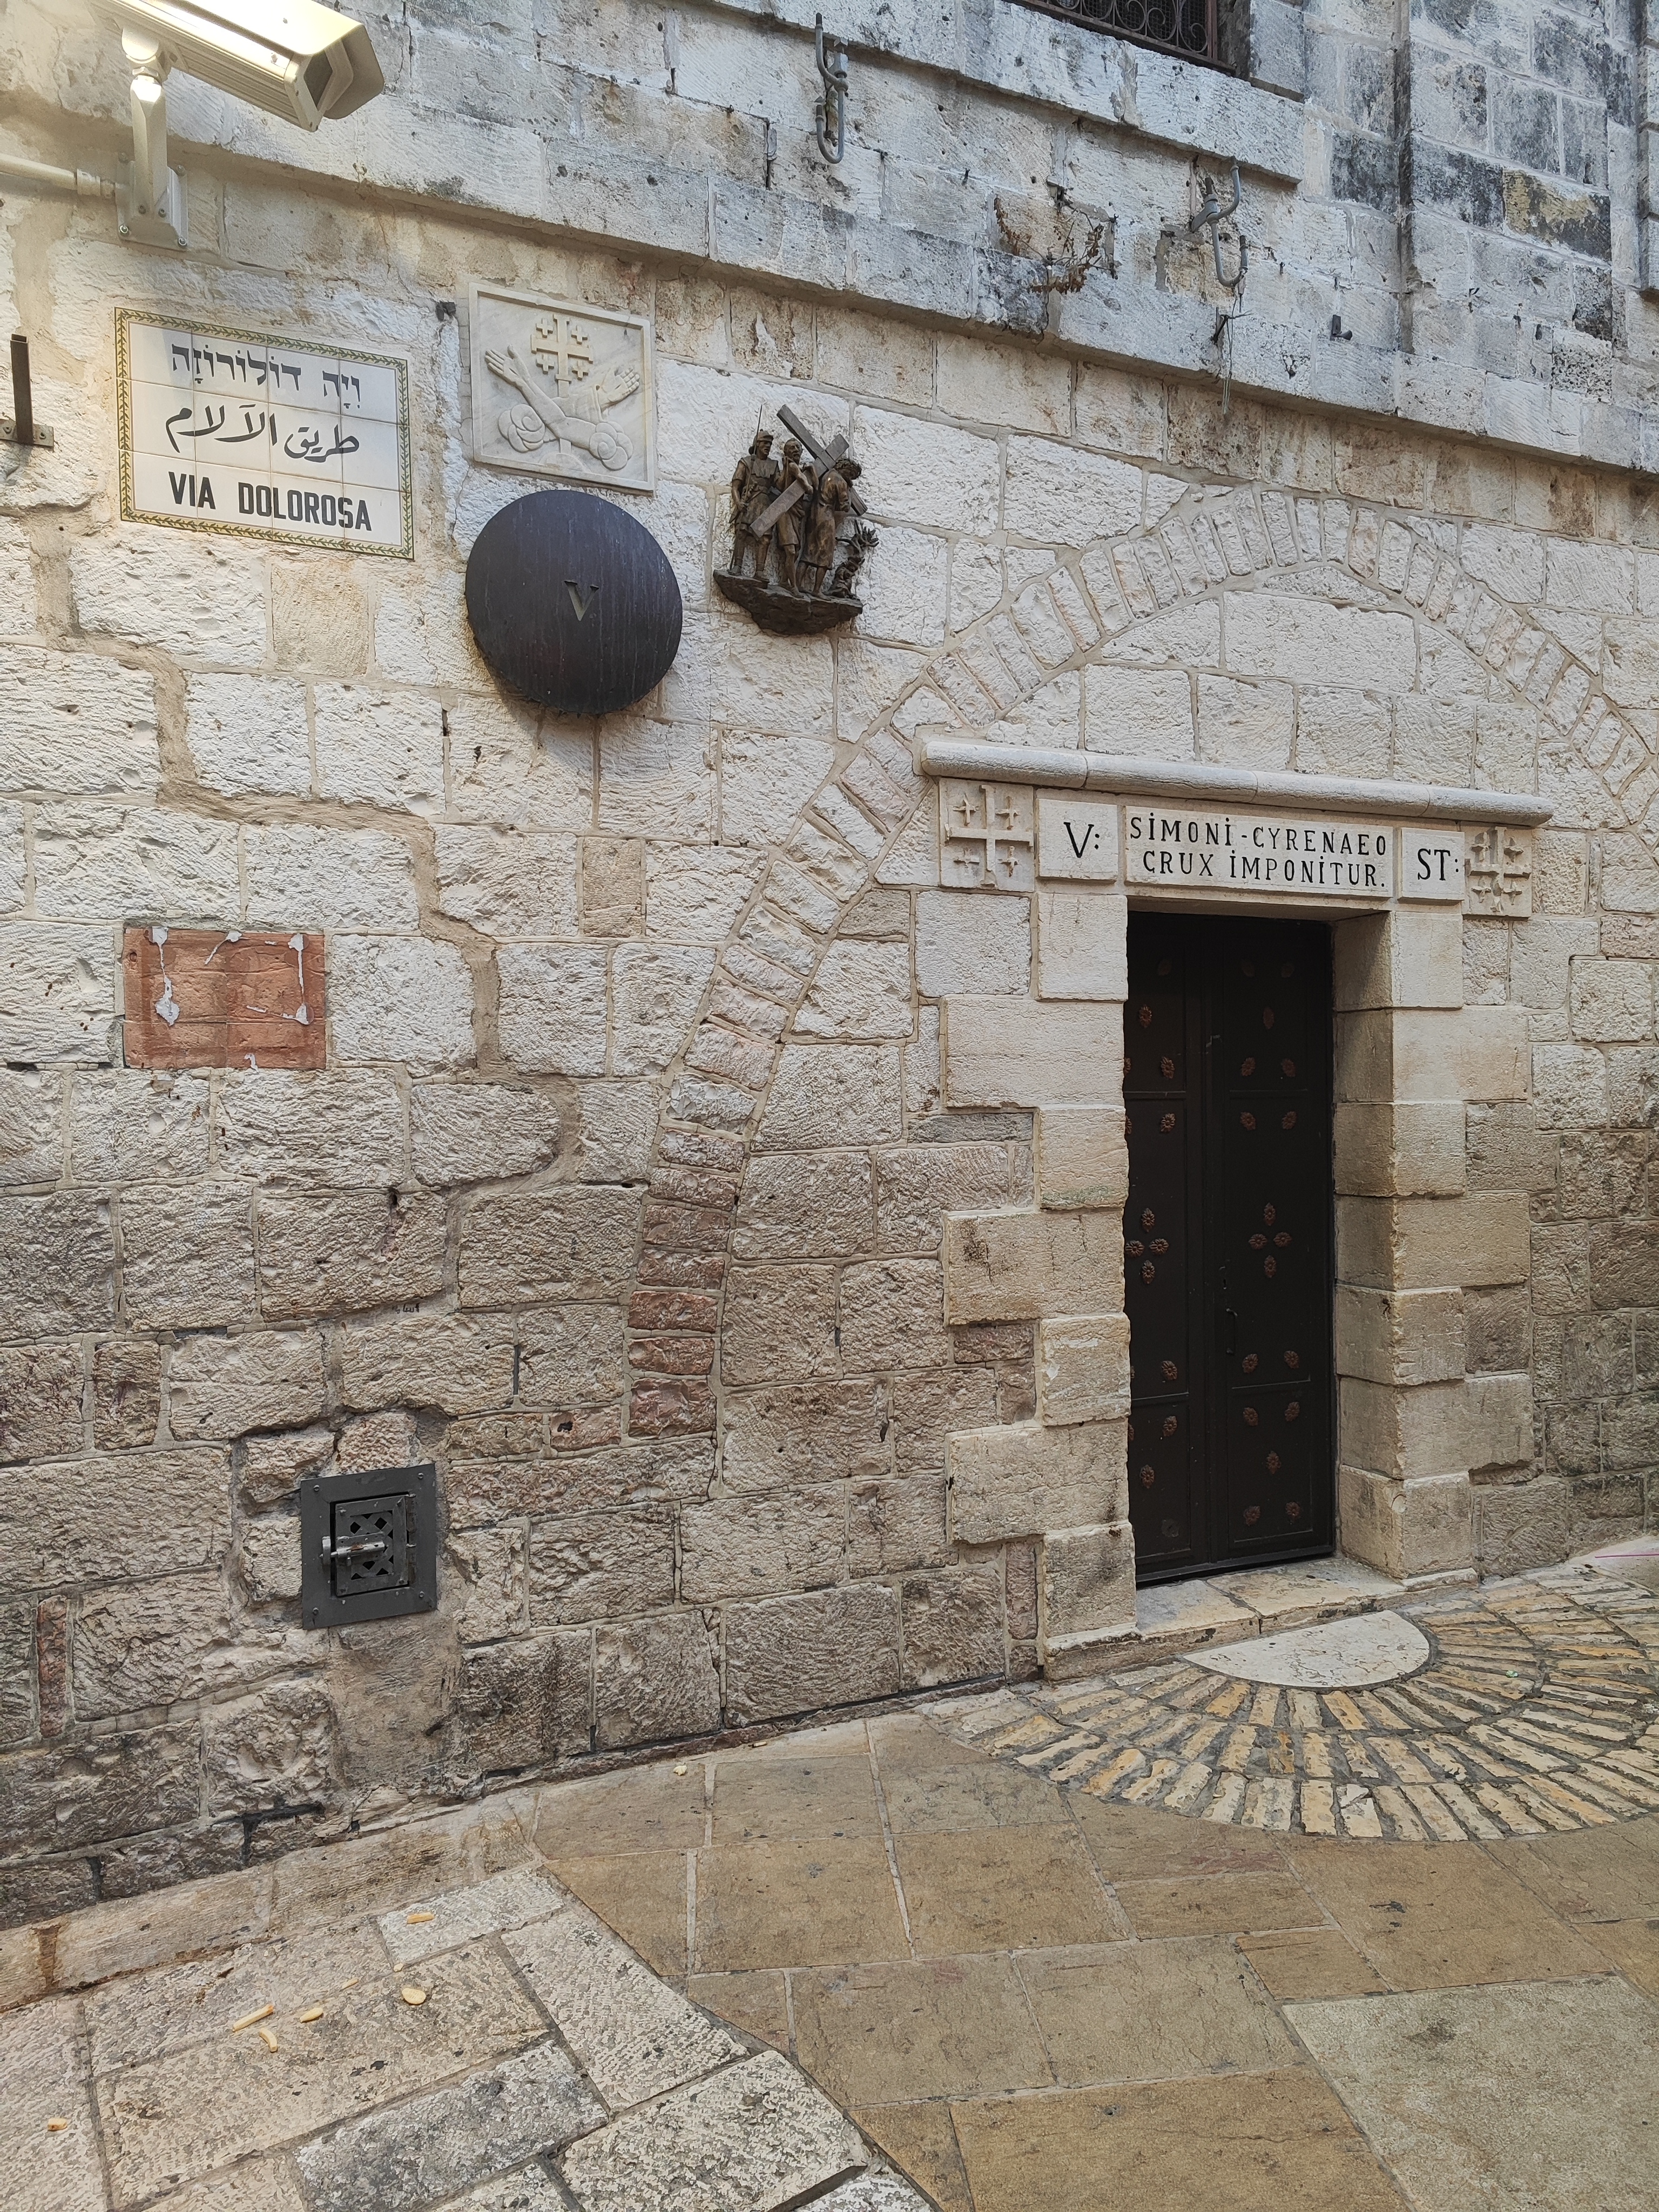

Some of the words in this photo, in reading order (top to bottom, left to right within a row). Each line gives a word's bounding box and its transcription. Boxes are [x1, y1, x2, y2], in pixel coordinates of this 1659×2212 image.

[165, 403, 278, 453] الآلام
[284, 423, 360, 463] طريق
[168, 471, 215, 509] VIA
[238, 482, 372, 531] DOLOROSA
[564, 580, 599, 621] V
[1063, 821, 1100, 858] V:
[1143, 850, 1213, 876] CRUX
